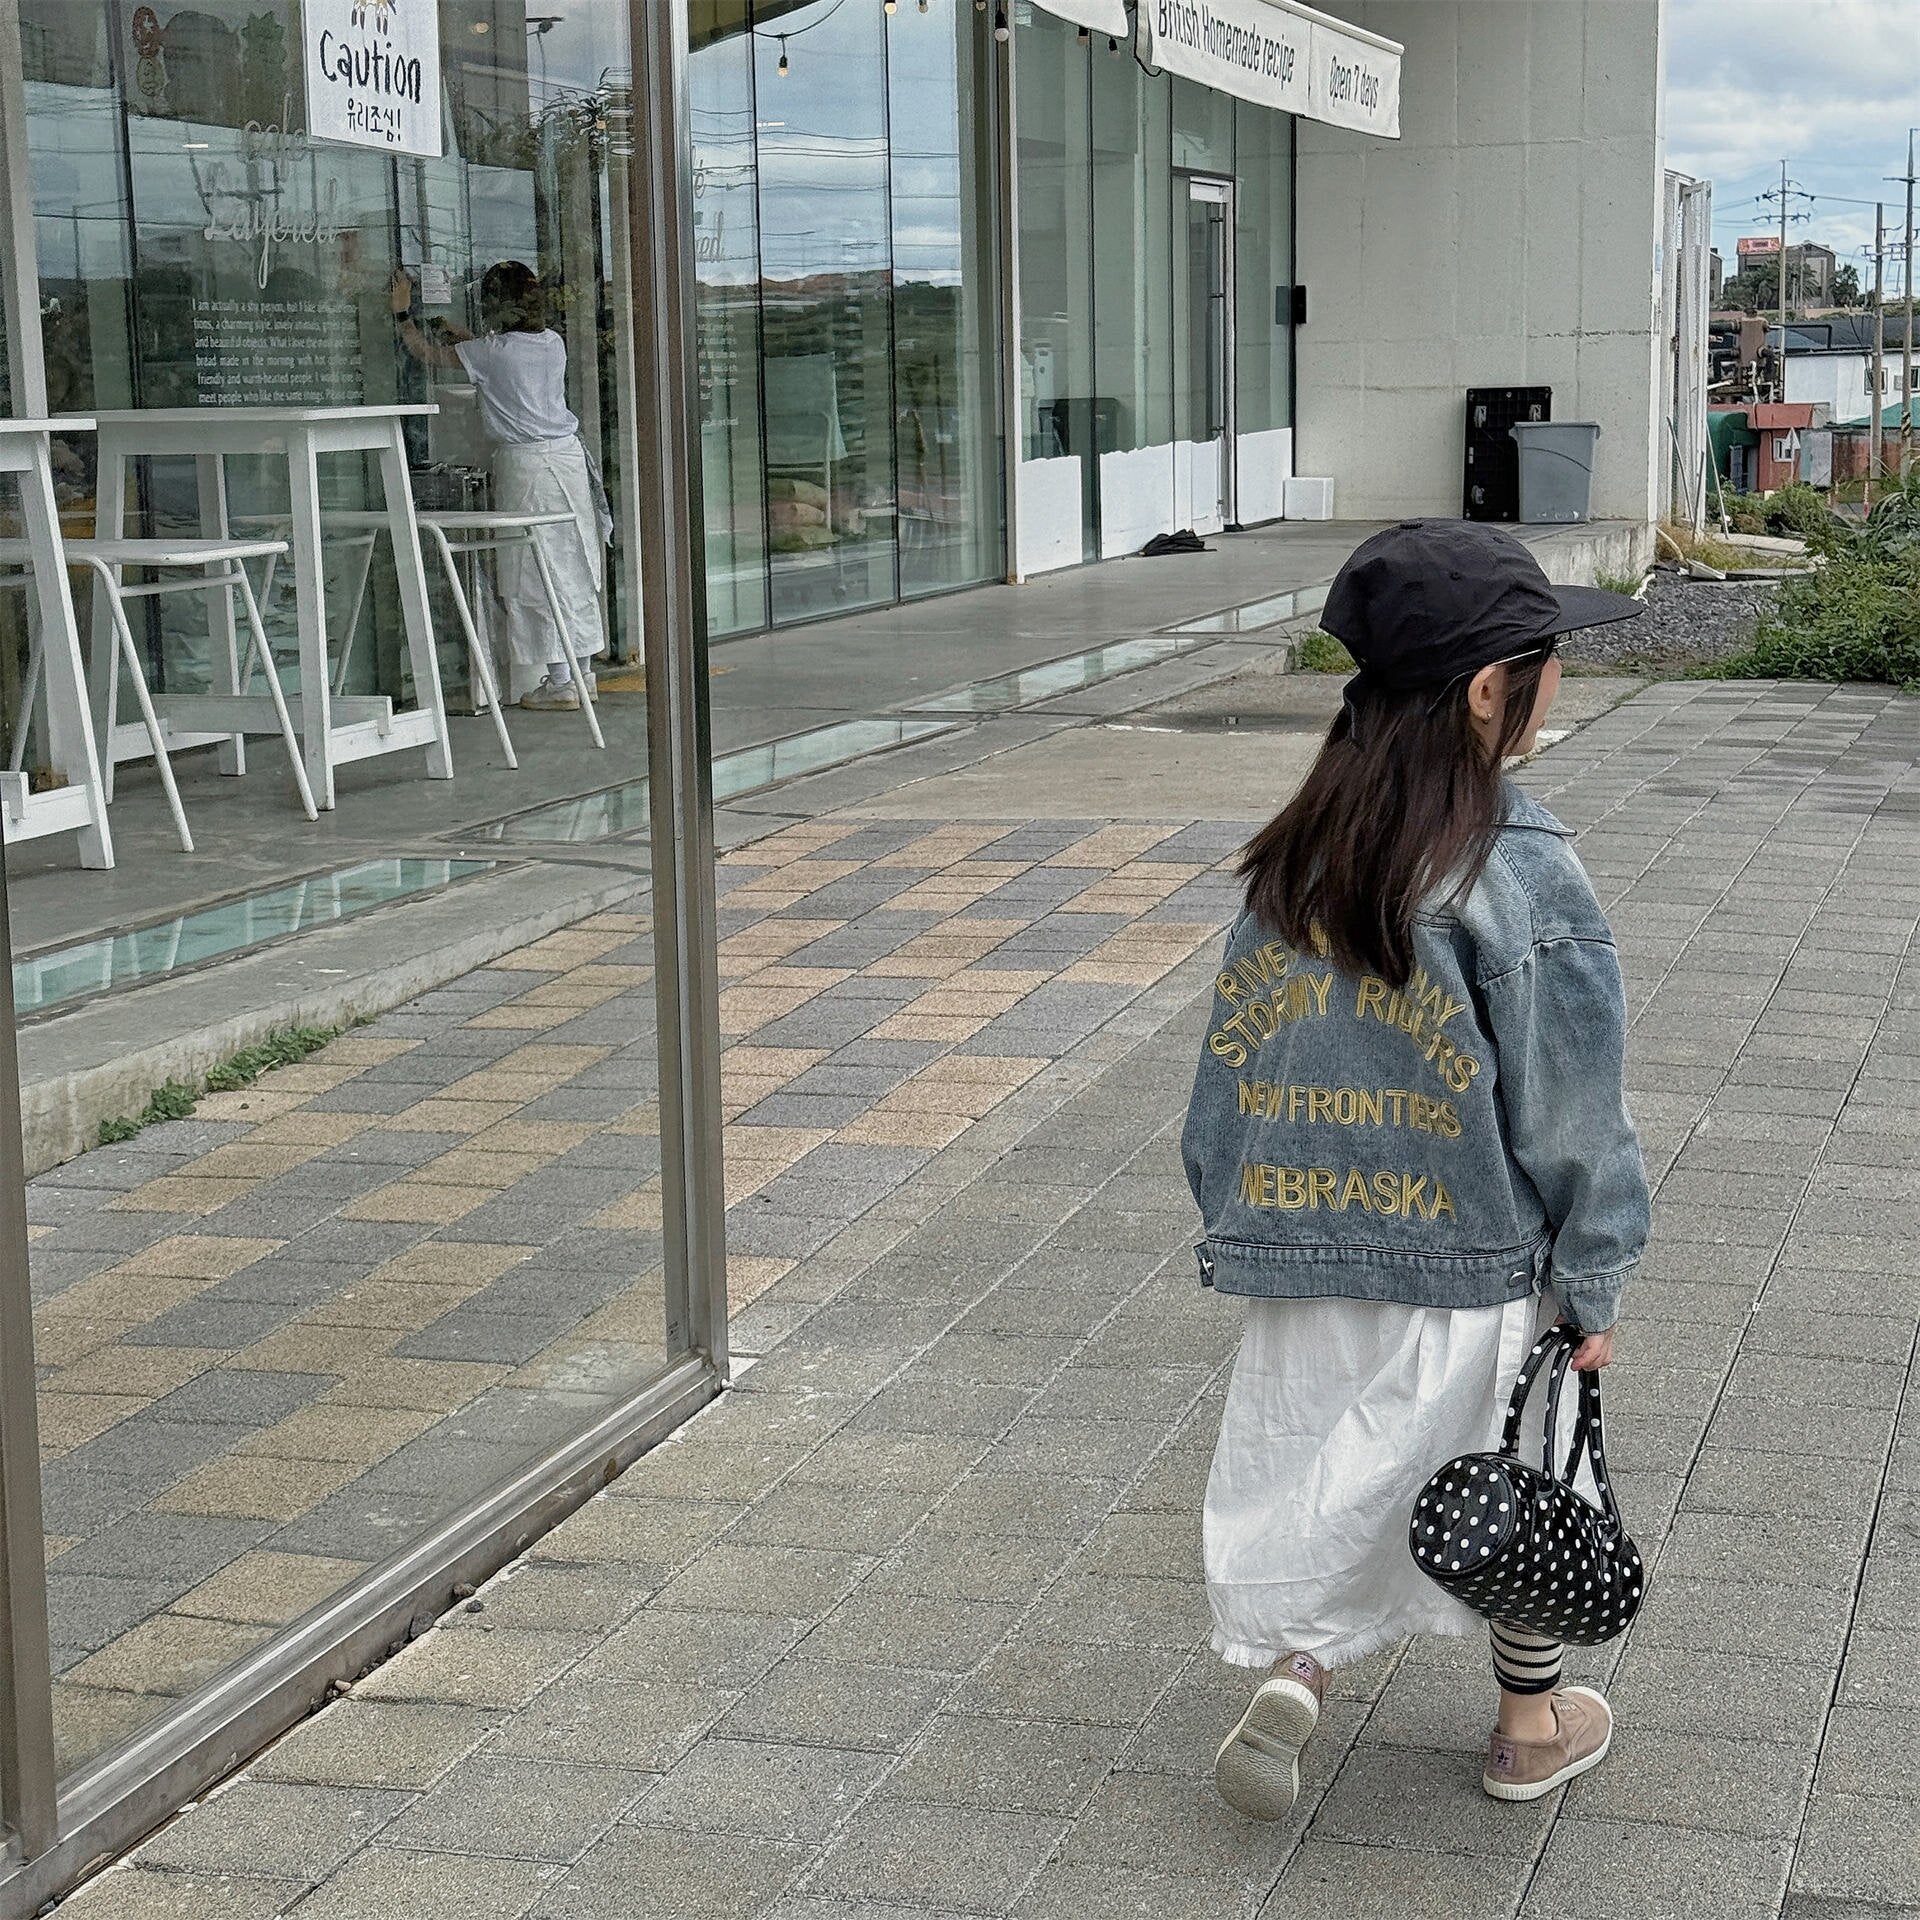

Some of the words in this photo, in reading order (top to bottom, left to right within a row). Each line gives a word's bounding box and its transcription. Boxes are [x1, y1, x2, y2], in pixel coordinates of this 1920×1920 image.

[320, 29, 421, 104] Caution
[1158, 0, 1201, 50] British
[1201, 5, 1260, 72] Homemade
[1262, 34, 1296, 90] recipe
[1329, 55, 1352, 107] Open
[1354, 65, 1360, 104] 7
[1361, 64, 1380, 117] days
[347, 98, 401, 142] 유리조심!
[218, 390, 242, 406] people
[1215, 938, 1297, 1008] RIVE
[1238, 1162, 1458, 1224] NEBRASKA
